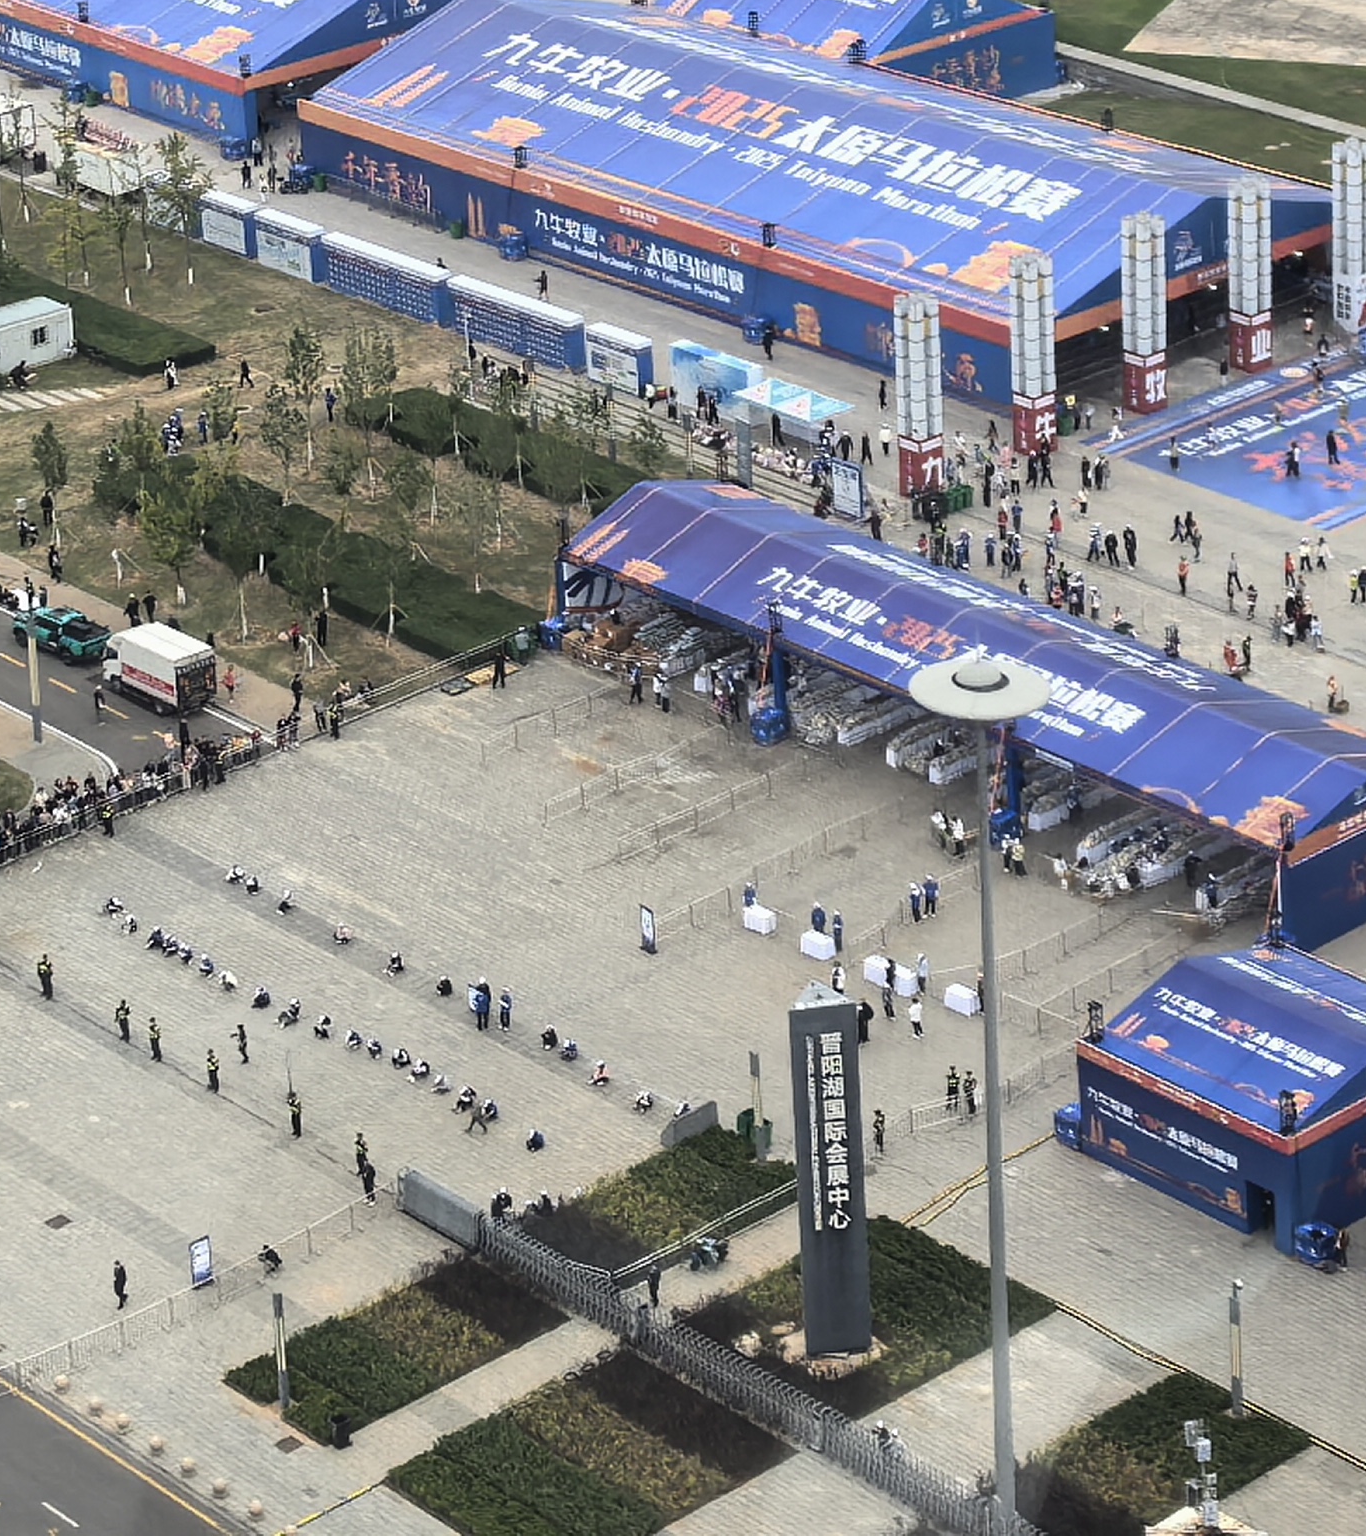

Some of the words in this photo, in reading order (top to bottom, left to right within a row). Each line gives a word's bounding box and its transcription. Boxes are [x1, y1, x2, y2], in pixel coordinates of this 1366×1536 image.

[481, 31, 1083, 221] 九牛牧业·2025太原马拉松赛
[617, 101, 725, 155] Husbandry
[783, 160, 873, 197] Taiyuan
[871, 185, 983, 232] Marathon
[1035, 405, 1056, 441] 牛
